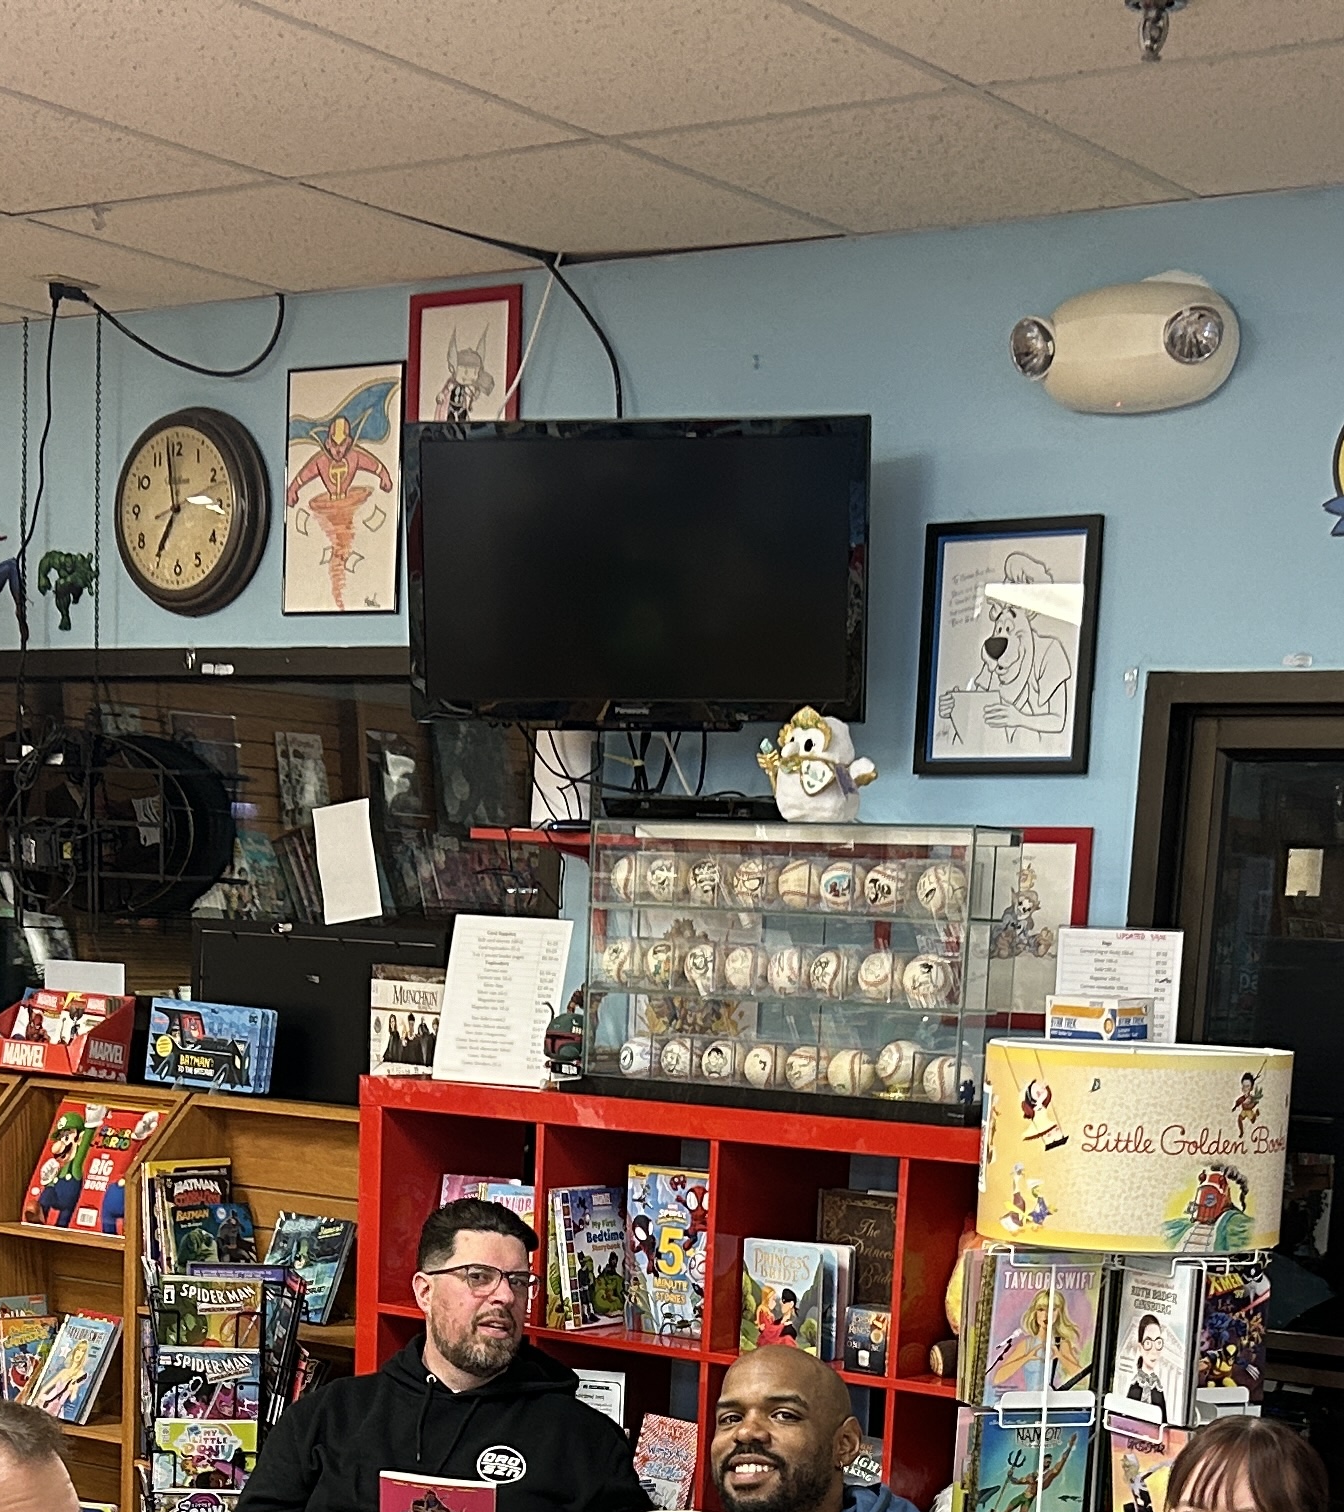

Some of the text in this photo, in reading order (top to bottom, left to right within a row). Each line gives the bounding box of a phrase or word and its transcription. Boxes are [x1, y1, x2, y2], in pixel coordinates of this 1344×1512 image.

[171, 441, 184, 458] 12
[195, 449, 201, 464] 1
[152, 451, 164, 469] 11
[136, 474, 151, 491] 10
[209, 468, 218, 483] 2
[132, 504, 141, 520] 9
[137, 533, 146, 550] 8
[208, 529, 217, 545] 4
[174, 559, 182, 576] 6
[193, 552, 202, 568] 5
[393, 984, 438, 1006] MUNCHKIN
[1051, 1017, 1076, 1028] STAR TREK
[4, 1042, 44, 1067] MARVEL
[89, 1040, 123, 1064] MARVEL
[100, 1126, 132, 1137] SUPER
[1082, 1124, 1248, 1156] Little Golden
[91, 1137, 131, 1150] MARIO
[89, 1158, 114, 1176] BIG
[84, 1181, 108, 1192] BOOK
[174, 1178, 222, 1195] BATMAN
[176, 1209, 209, 1221] BATMAN
[592, 1219, 616, 1229] My First
[855, 1219, 881, 1237] The
[586, 1229, 625, 1243] Bedtime
[658, 1228, 684, 1275] 5
[753, 1246, 810, 1280] PRINCESS
[761, 1265, 799, 1282] BRIDE
[1004, 1271, 1095, 1290] TAYLOR SWIFT
[1208, 1274, 1242, 1295] X-MEN
[166, 1291, 173, 1302] 1
[173, 1354, 253, 1373] SPIDER-MAN
[483, 1453, 520, 1464] DAD
